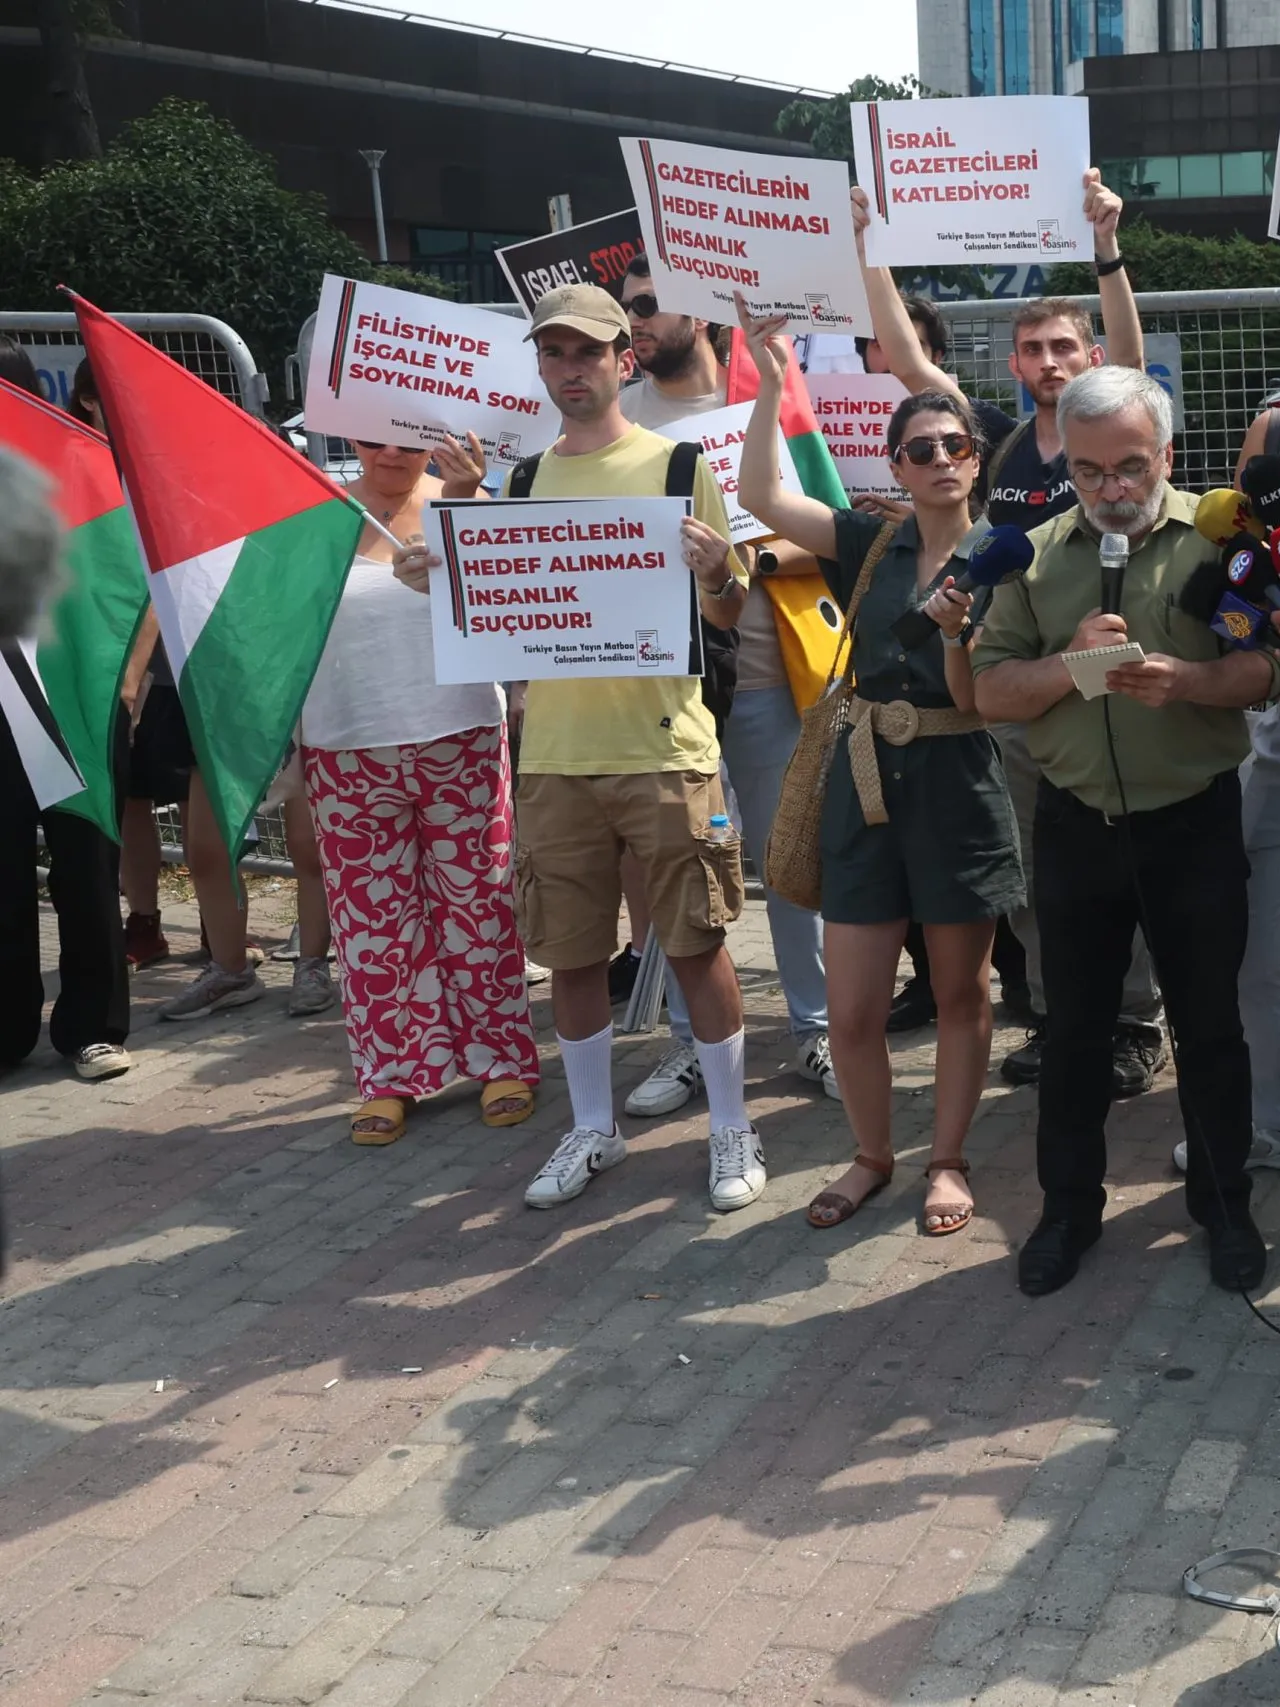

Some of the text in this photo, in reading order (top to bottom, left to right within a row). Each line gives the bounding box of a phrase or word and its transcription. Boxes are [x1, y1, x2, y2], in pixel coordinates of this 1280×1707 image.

[887, 126, 956, 149] İSRAİL
[890, 148, 1038, 175] GAZETECİLERİ
[657, 162, 810, 201] GAZETECİLERİN
[892, 180, 1030, 203] KATLEDİYOR!
[662, 194, 830, 235] HEDEF ALINMASI
[665, 220, 748, 258] İNSANLIK
[937, 232, 963, 241] Türkiye
[1008, 230, 1037, 239] Matbaa
[670, 253, 760, 288] SUÇUDUR!
[357, 312, 491, 357] FİLİSTİN'DE
[353, 333, 475, 377] İŞGALE VE
[349, 363, 541, 415] SOYKIRIMA SON!
[391, 419, 420, 430] Türkiye
[859, 423, 883, 436] VE
[459, 516, 645, 547] GAZETECİLERİN
[464, 551, 665, 576] HEDEF ALINMASI
[1231, 554, 1250, 580] SZC
[467, 584, 579, 606] İNSANLIK
[471, 612, 592, 636] SUÇUDUR!
[523, 641, 635, 654] Türkiye Basın Yayın Matbaa
[554, 654, 636, 666] Çalışanları Sendikası
